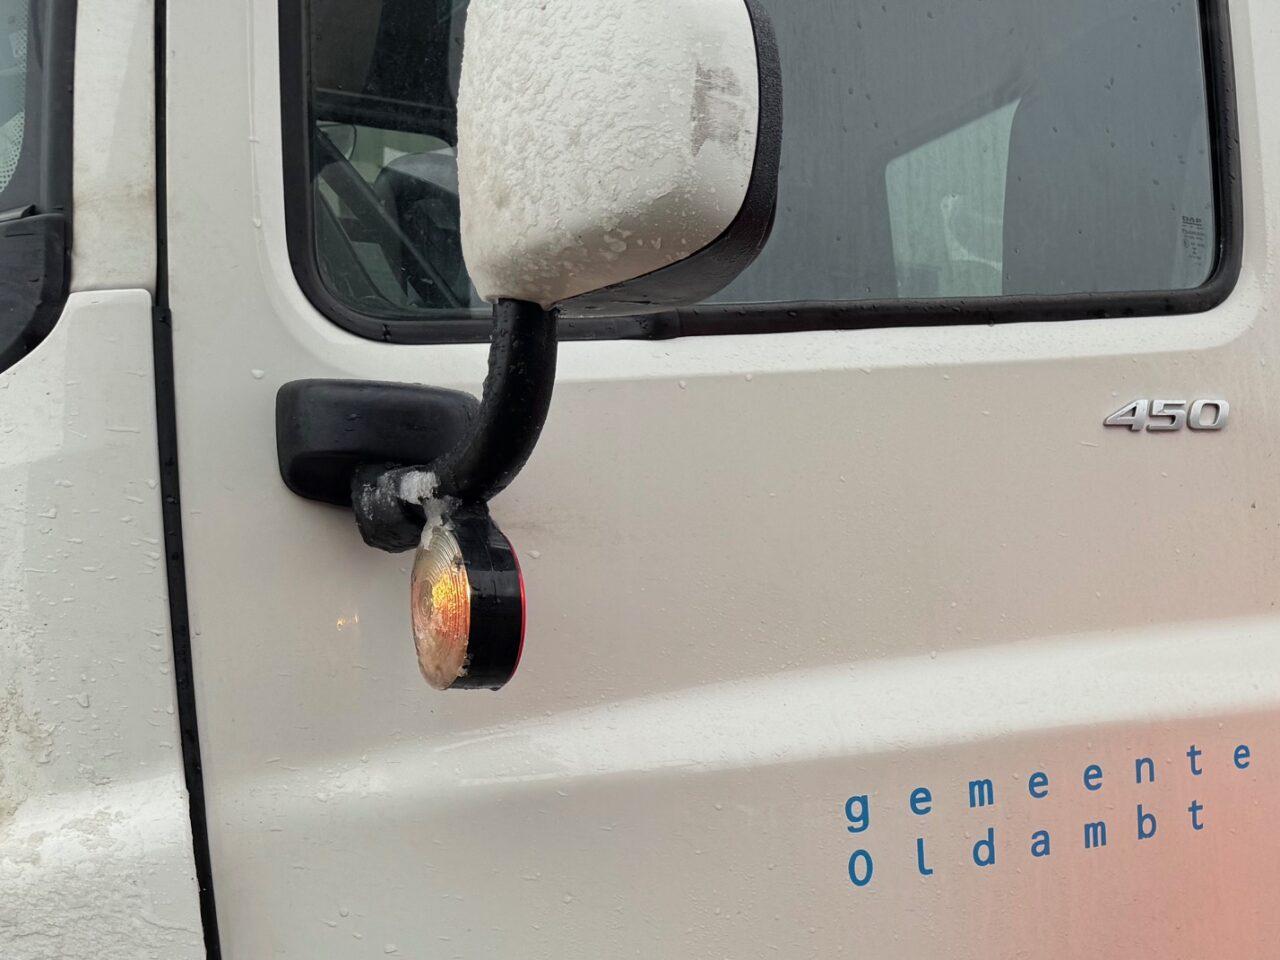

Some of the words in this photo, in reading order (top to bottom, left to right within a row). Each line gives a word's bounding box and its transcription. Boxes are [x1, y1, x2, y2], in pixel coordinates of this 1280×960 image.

[1103, 399, 1230, 432] 450
[845, 744, 1251, 834] gemeente
[848, 800, 1204, 887] Oldambt
